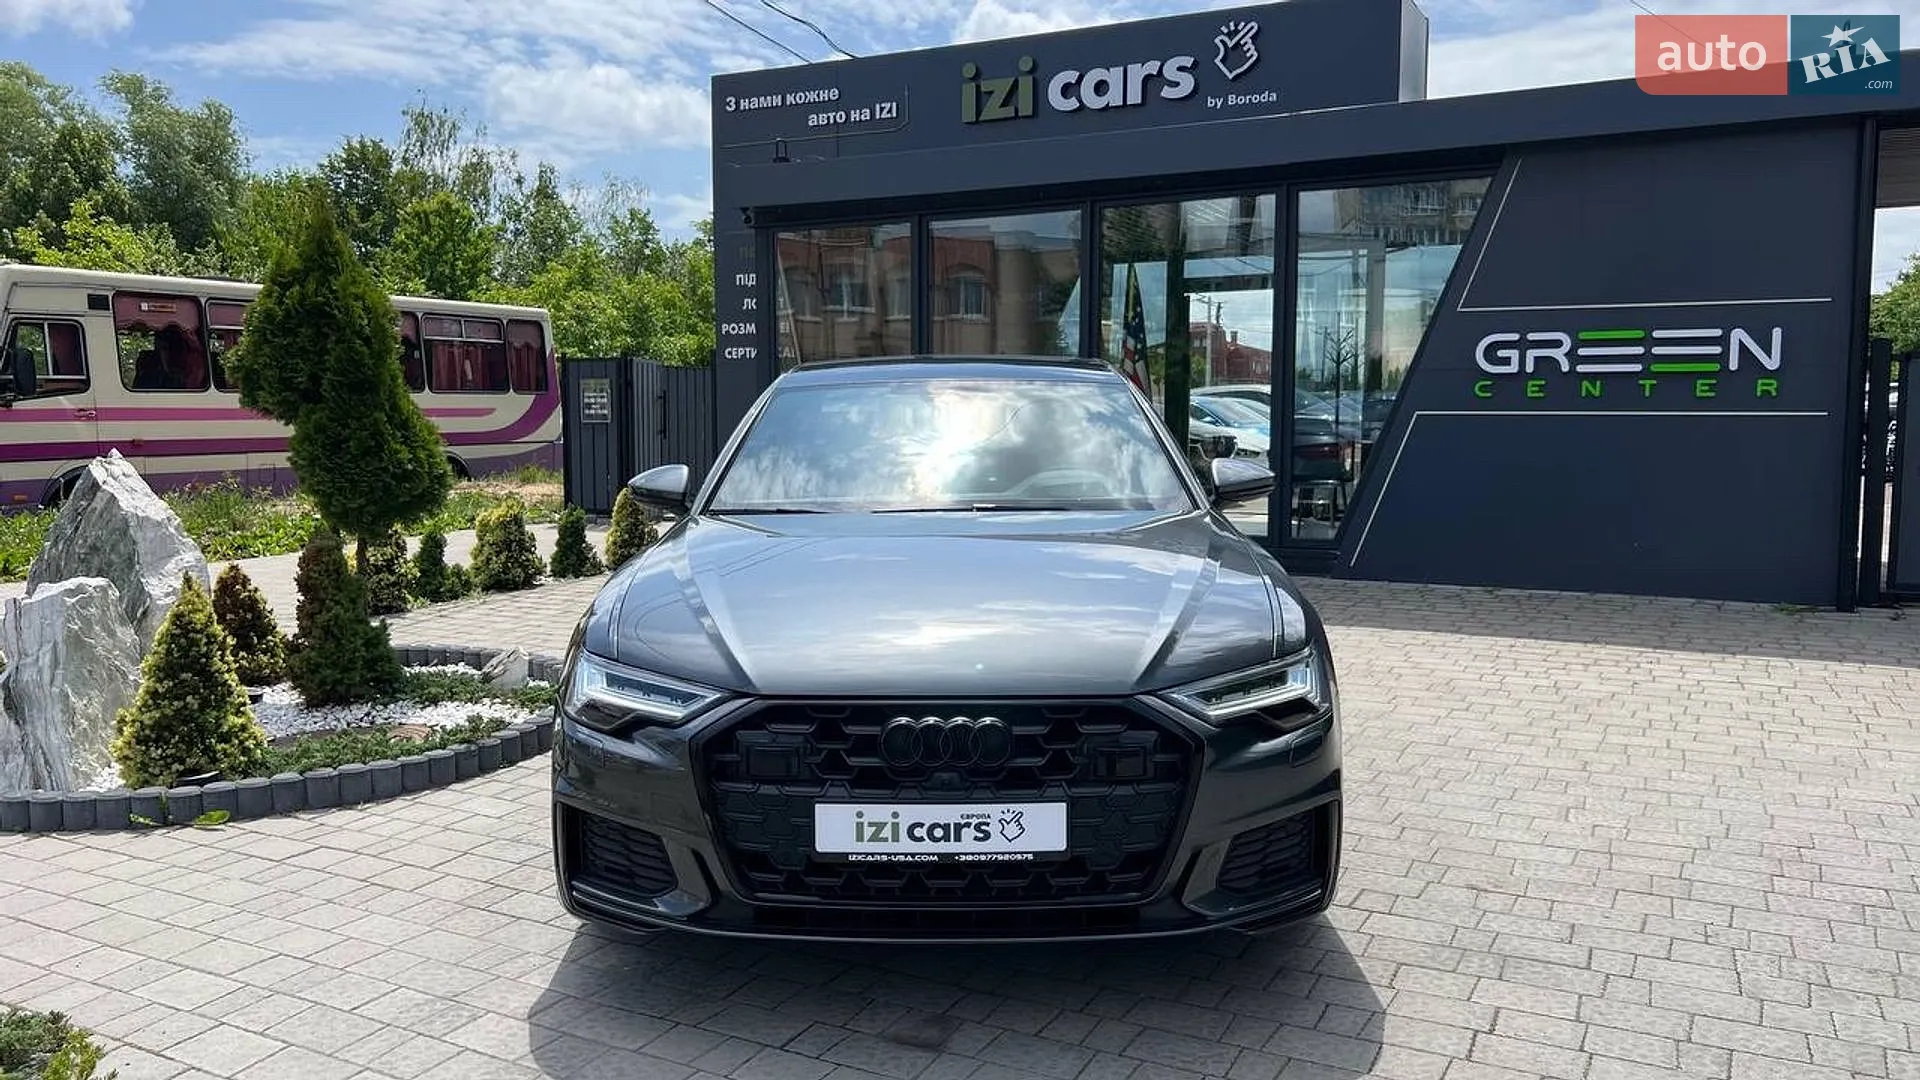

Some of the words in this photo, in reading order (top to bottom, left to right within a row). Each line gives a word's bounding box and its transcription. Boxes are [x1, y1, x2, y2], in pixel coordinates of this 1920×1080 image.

[725, 96, 736, 111] З
[740, 94, 782, 110] нами
[786, 87, 839, 106] кожне
[962, 56, 1034, 123] izi
[1048, 56, 1196, 111] cars
[1206, 95, 1223, 108] by
[1228, 91, 1277, 105] Boroda
[808, 111, 847, 126] авто
[850, 107, 870, 121] на
[875, 102, 897, 119] IZI
[1475, 327, 1782, 374] GREEN
[1474, 379, 1779, 398] CENTER
[855, 811, 900, 843] izi
[906, 820, 991, 843] cars
[848, 854, 939, 862] IZICARS-USA.COM
